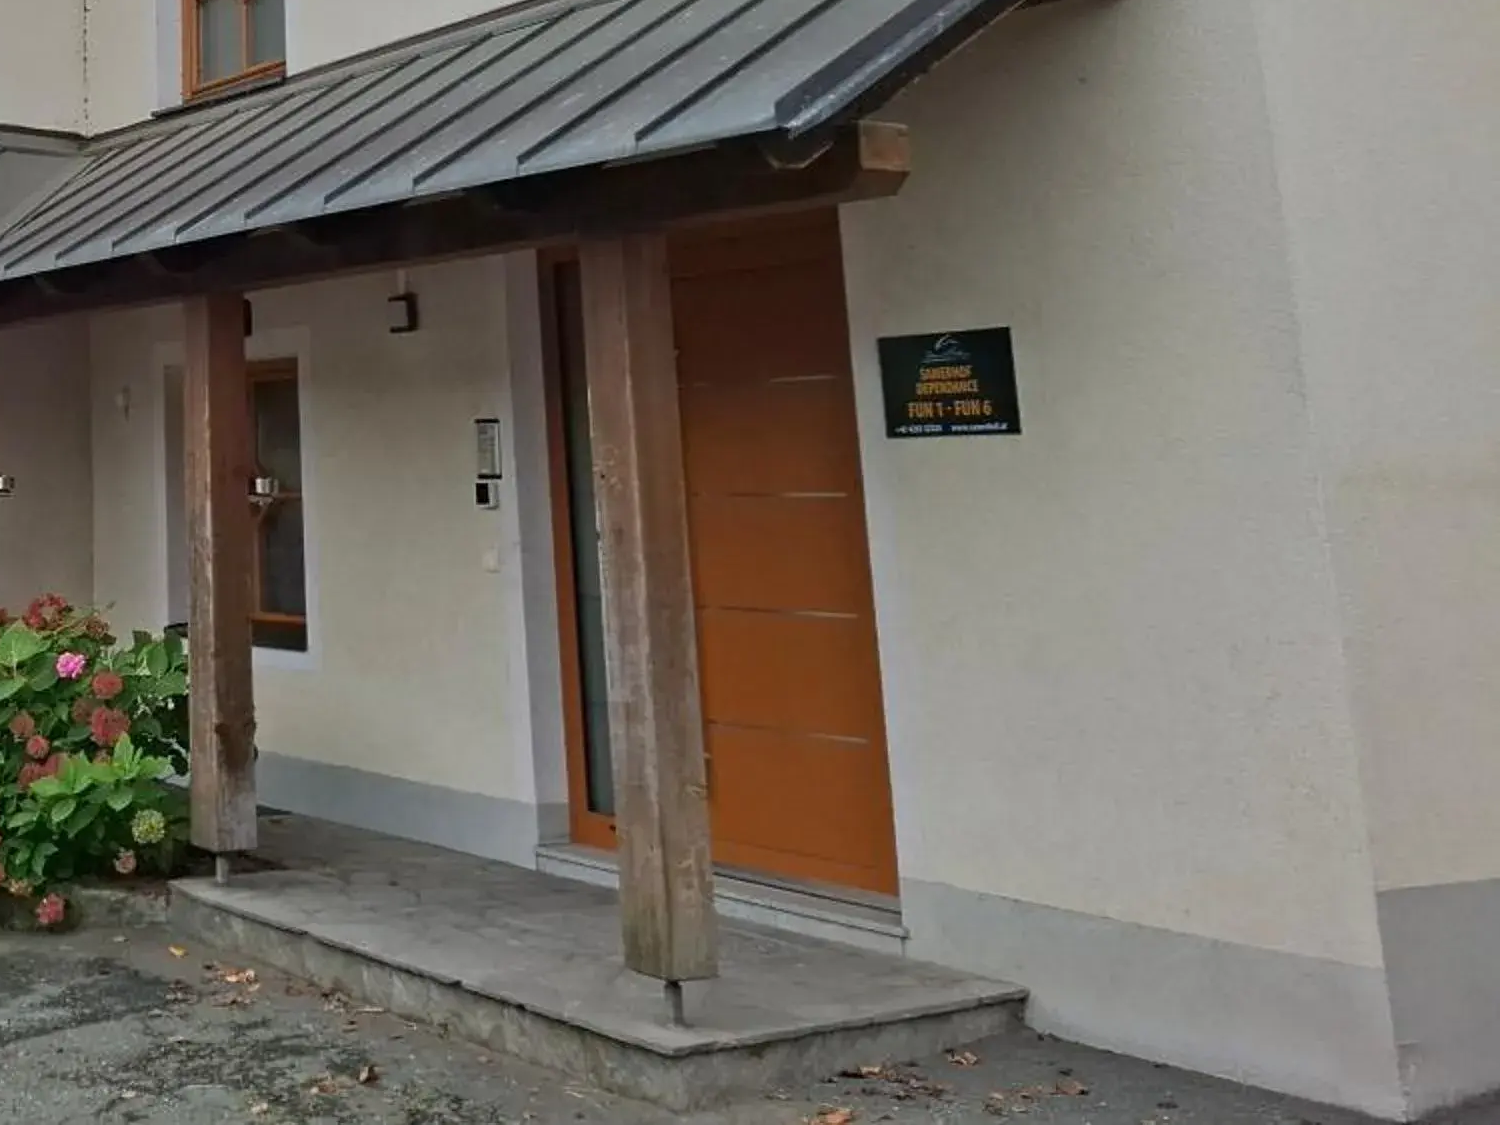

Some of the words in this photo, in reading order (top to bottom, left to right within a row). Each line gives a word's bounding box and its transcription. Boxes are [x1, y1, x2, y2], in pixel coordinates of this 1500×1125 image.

[907, 402, 933, 418] FUN
[935, 401, 943, 418] 1
[953, 399, 981, 416] FUN
[982, 399, 993, 416] 6
